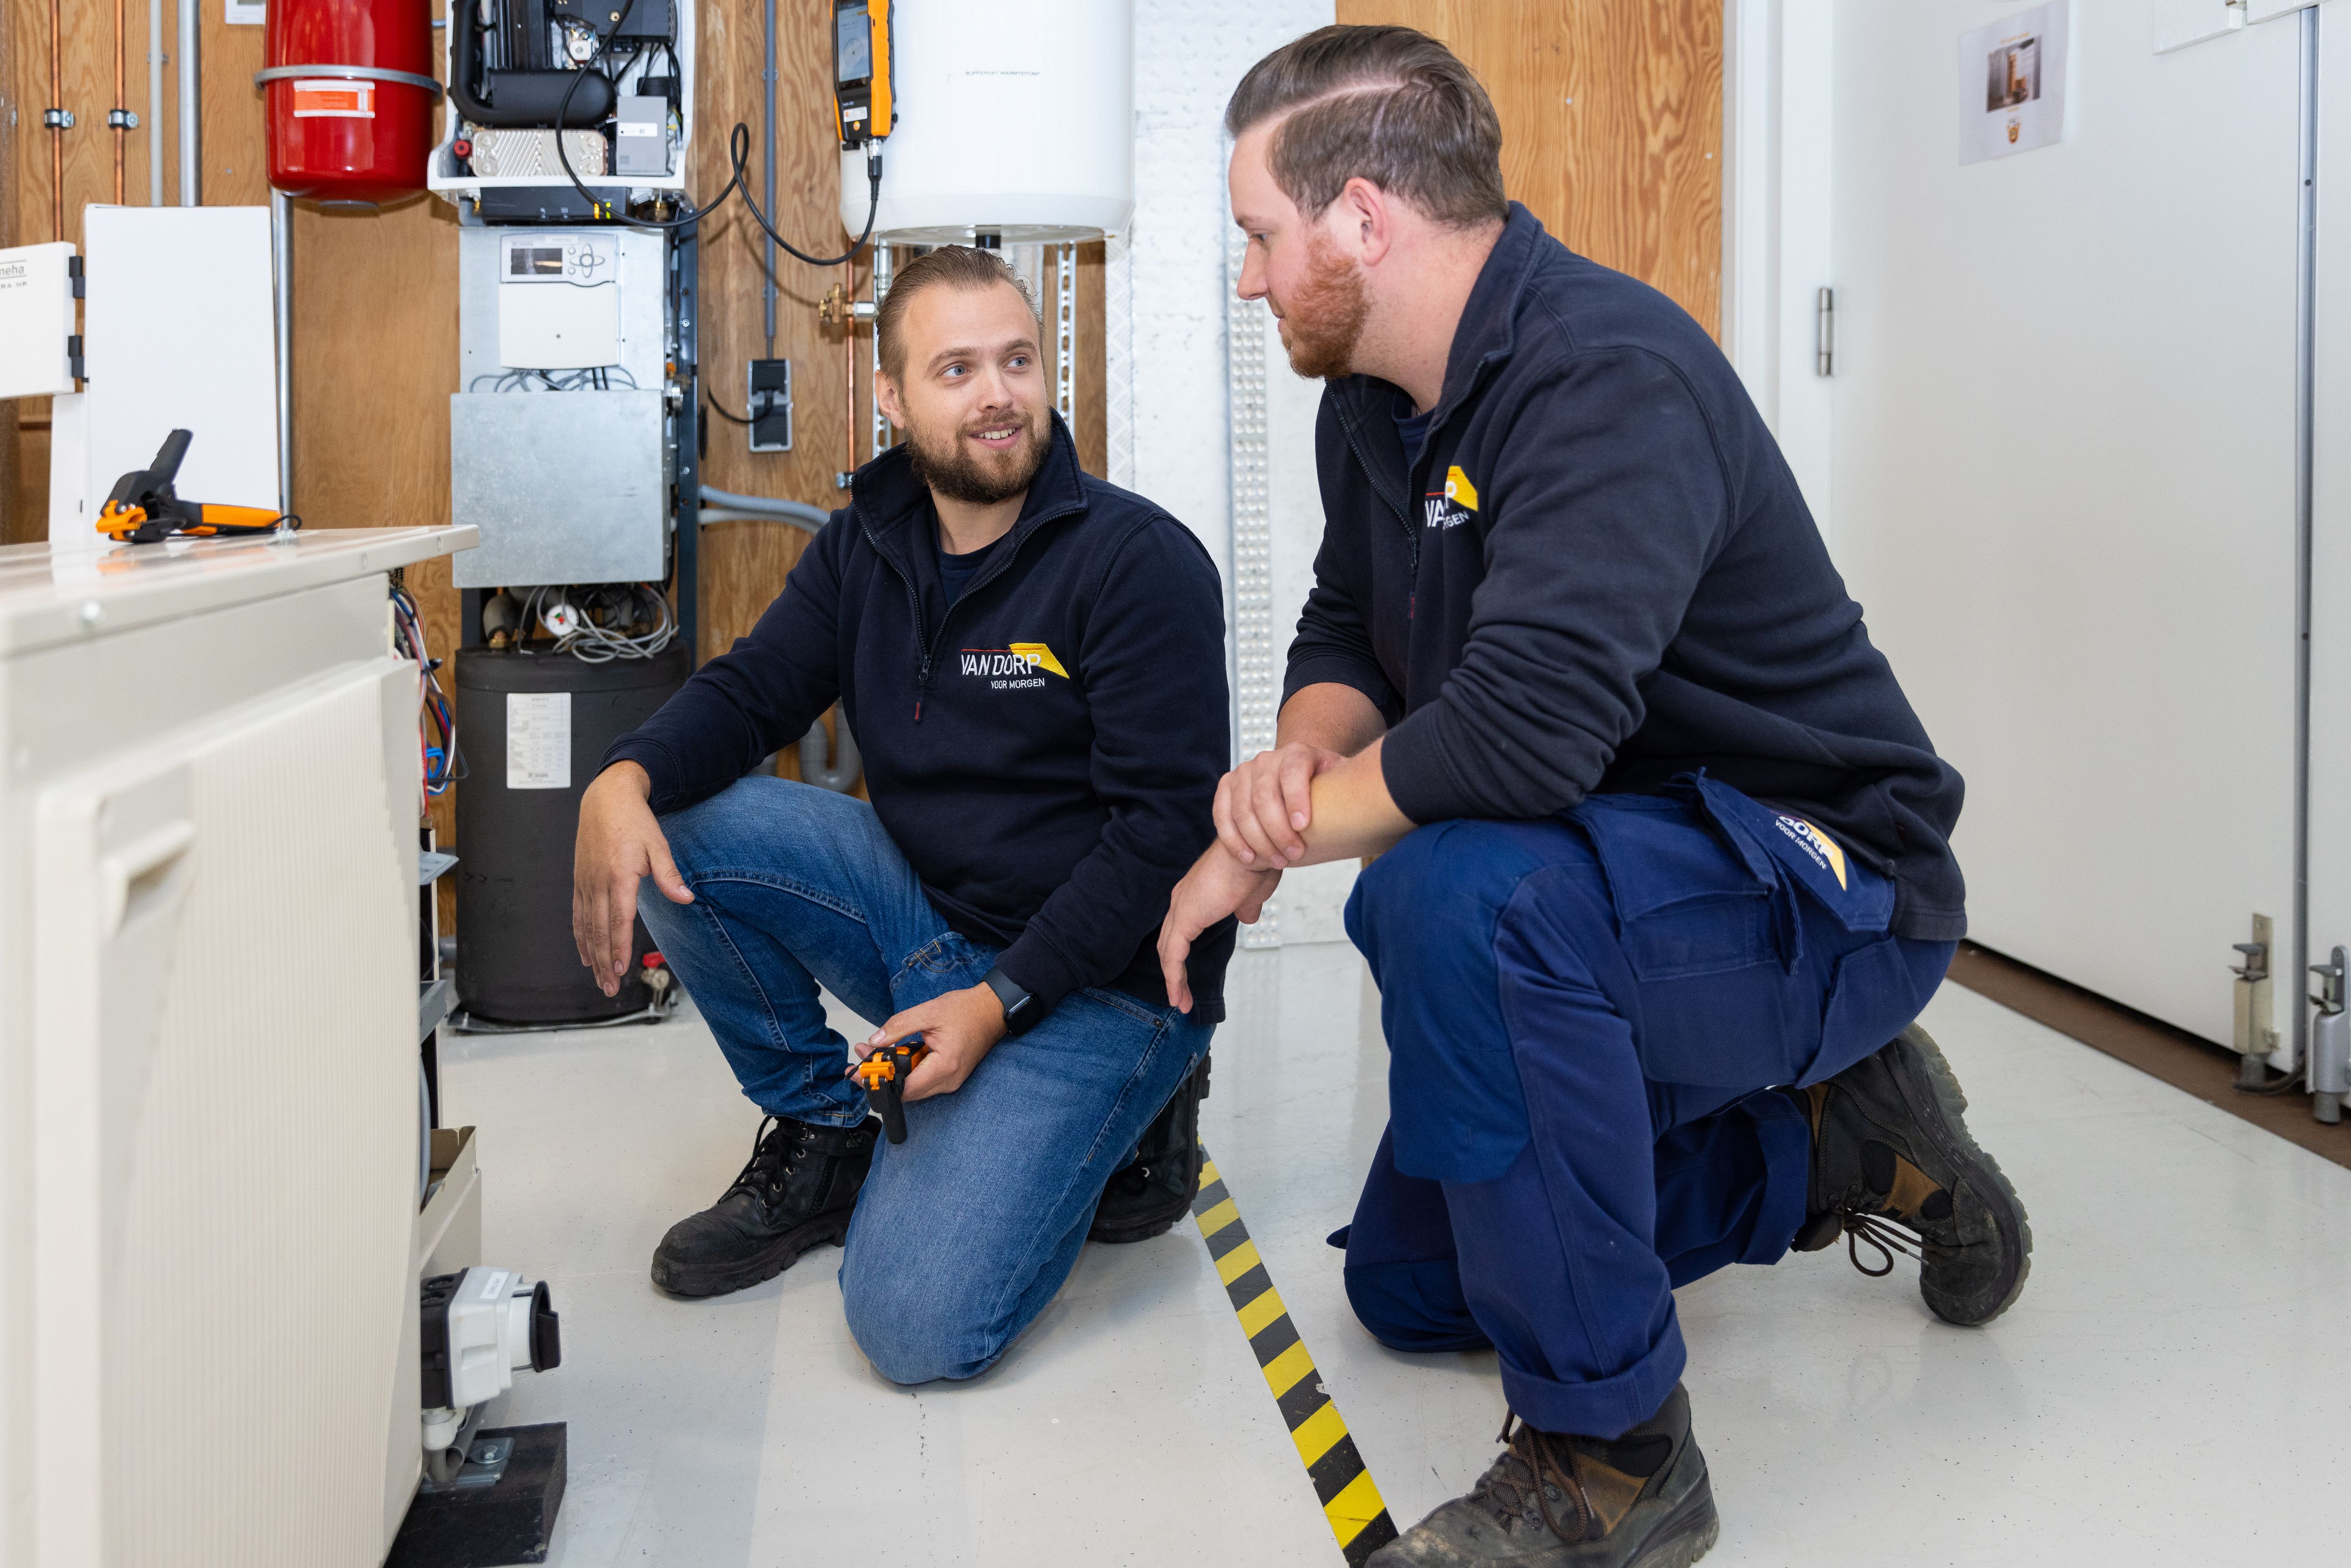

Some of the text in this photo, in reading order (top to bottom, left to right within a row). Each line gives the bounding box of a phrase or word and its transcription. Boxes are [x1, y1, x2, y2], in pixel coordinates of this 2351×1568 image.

[961, 654, 1041, 675] VAN DORP
[991, 678, 1045, 689] VOOR MORGEN
[1775, 819, 1826, 870] VOOR MORGEN
